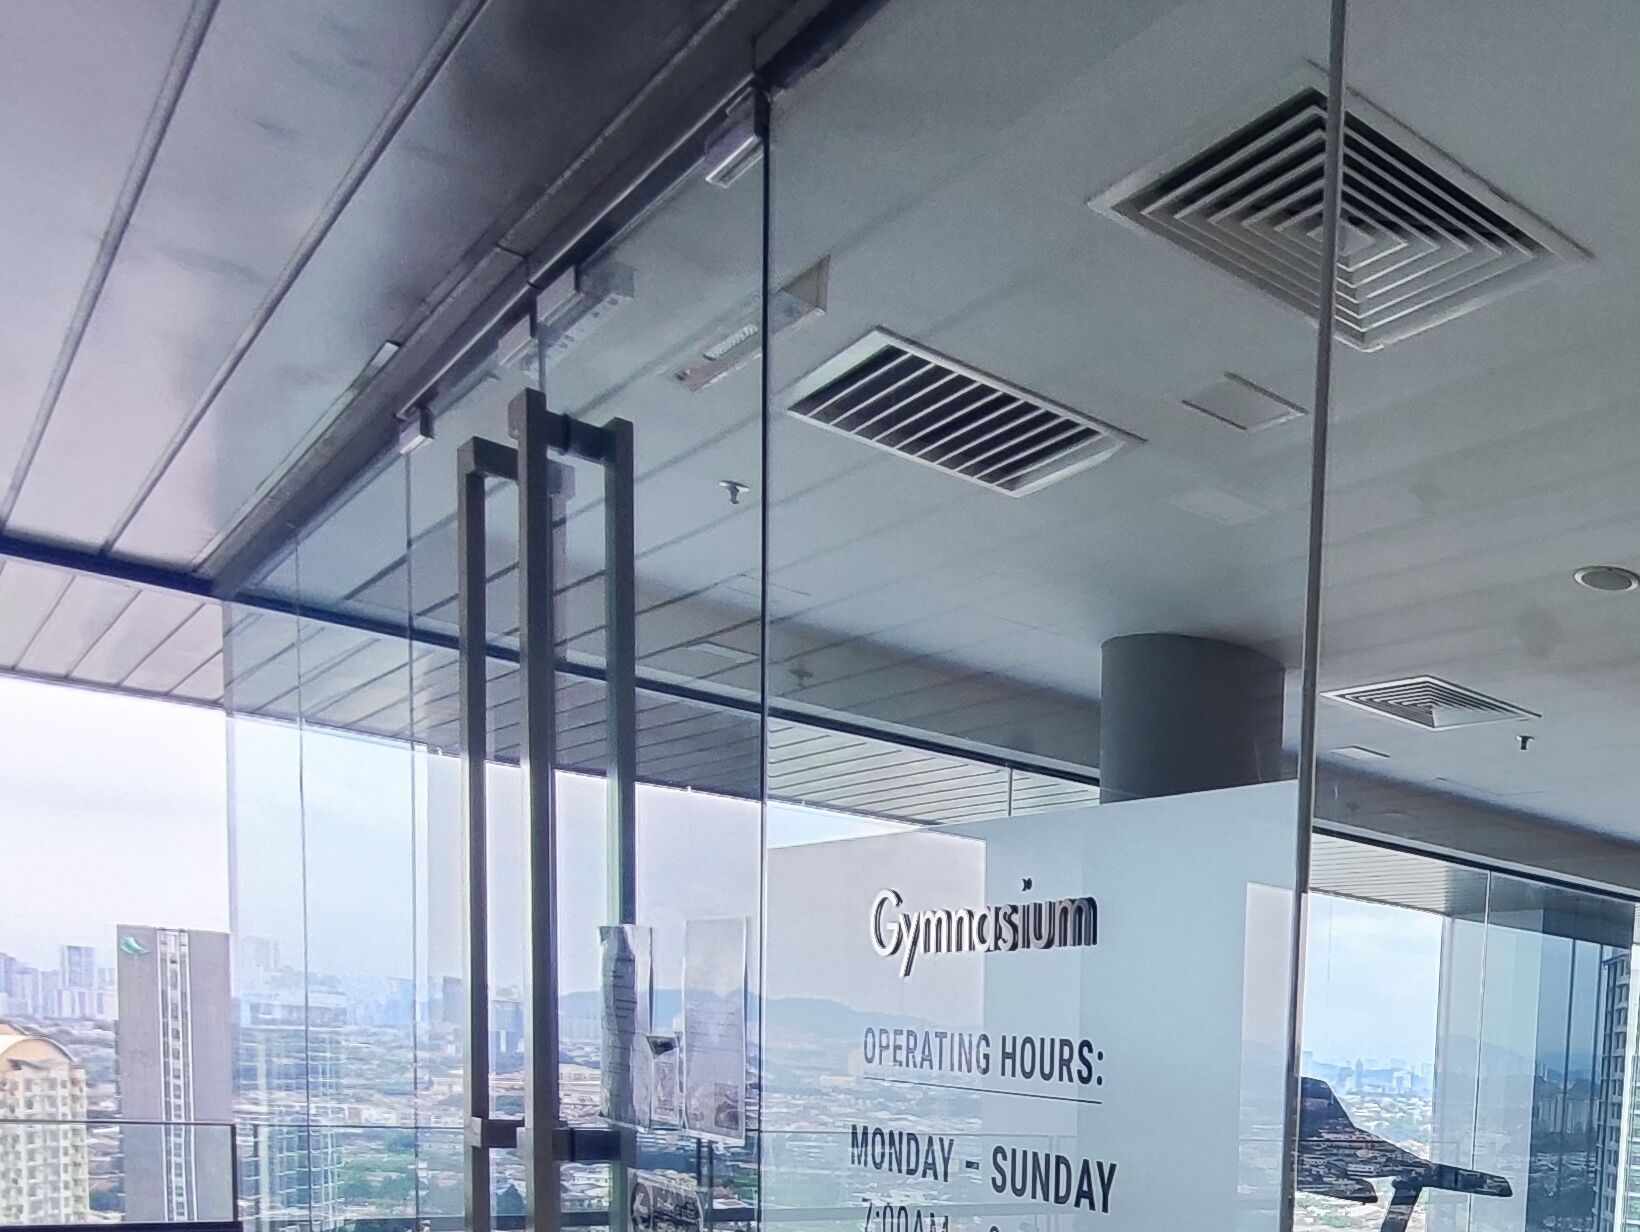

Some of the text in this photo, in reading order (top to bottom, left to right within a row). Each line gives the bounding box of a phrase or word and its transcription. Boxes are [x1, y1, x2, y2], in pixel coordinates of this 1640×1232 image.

[869, 877, 1098, 977] Gymnasium
[863, 1027, 1104, 1086] OPERATING HOURS:
[851, 1124, 955, 1182] MONDAY
[991, 1145, 1117, 1213] SUNDAY
